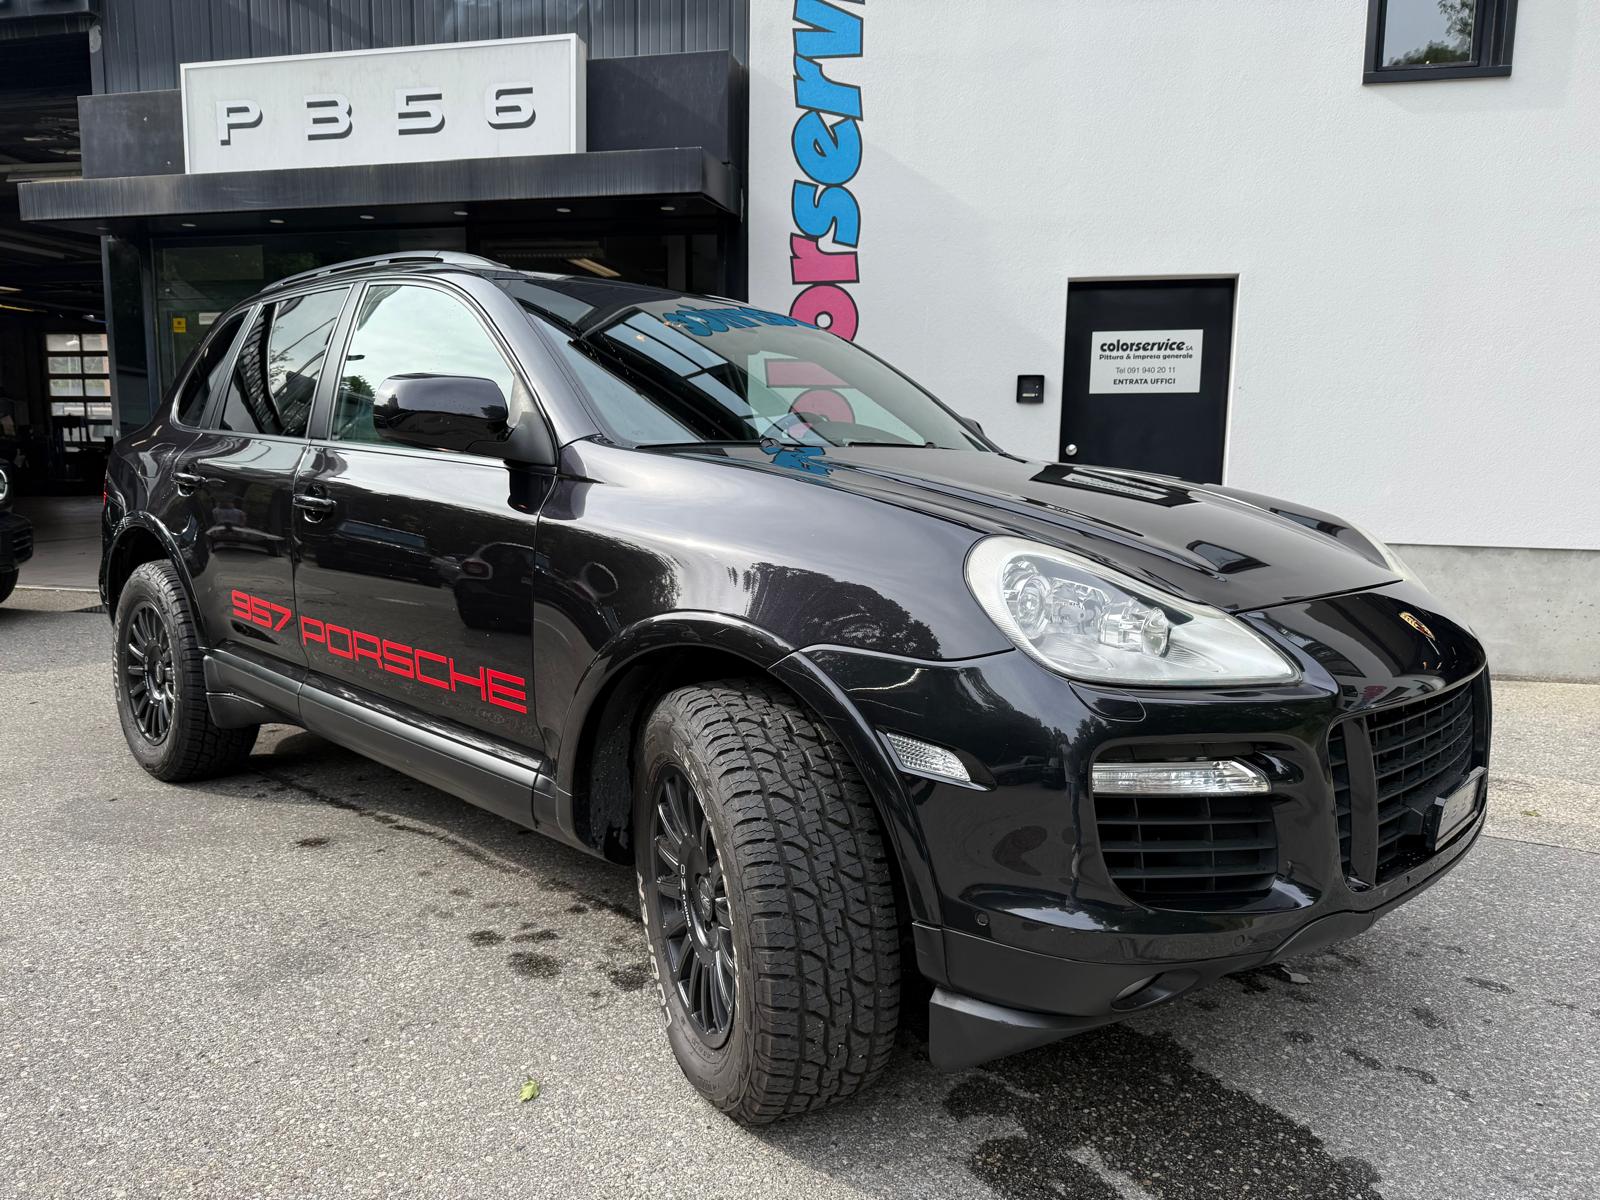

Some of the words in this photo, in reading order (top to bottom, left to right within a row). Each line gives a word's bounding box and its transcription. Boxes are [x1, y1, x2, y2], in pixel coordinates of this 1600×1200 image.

[1100, 338, 1186, 352] colorservice
[1162, 352, 1193, 360] generale
[1115, 366, 1126, 374] Tel
[1127, 366, 1140, 374] 091
[1142, 366, 1155, 374] 940
[1150, 377, 1176, 385] UFFICI
[231, 588, 292, 632] 957
[300, 615, 528, 714] PORSCHE
